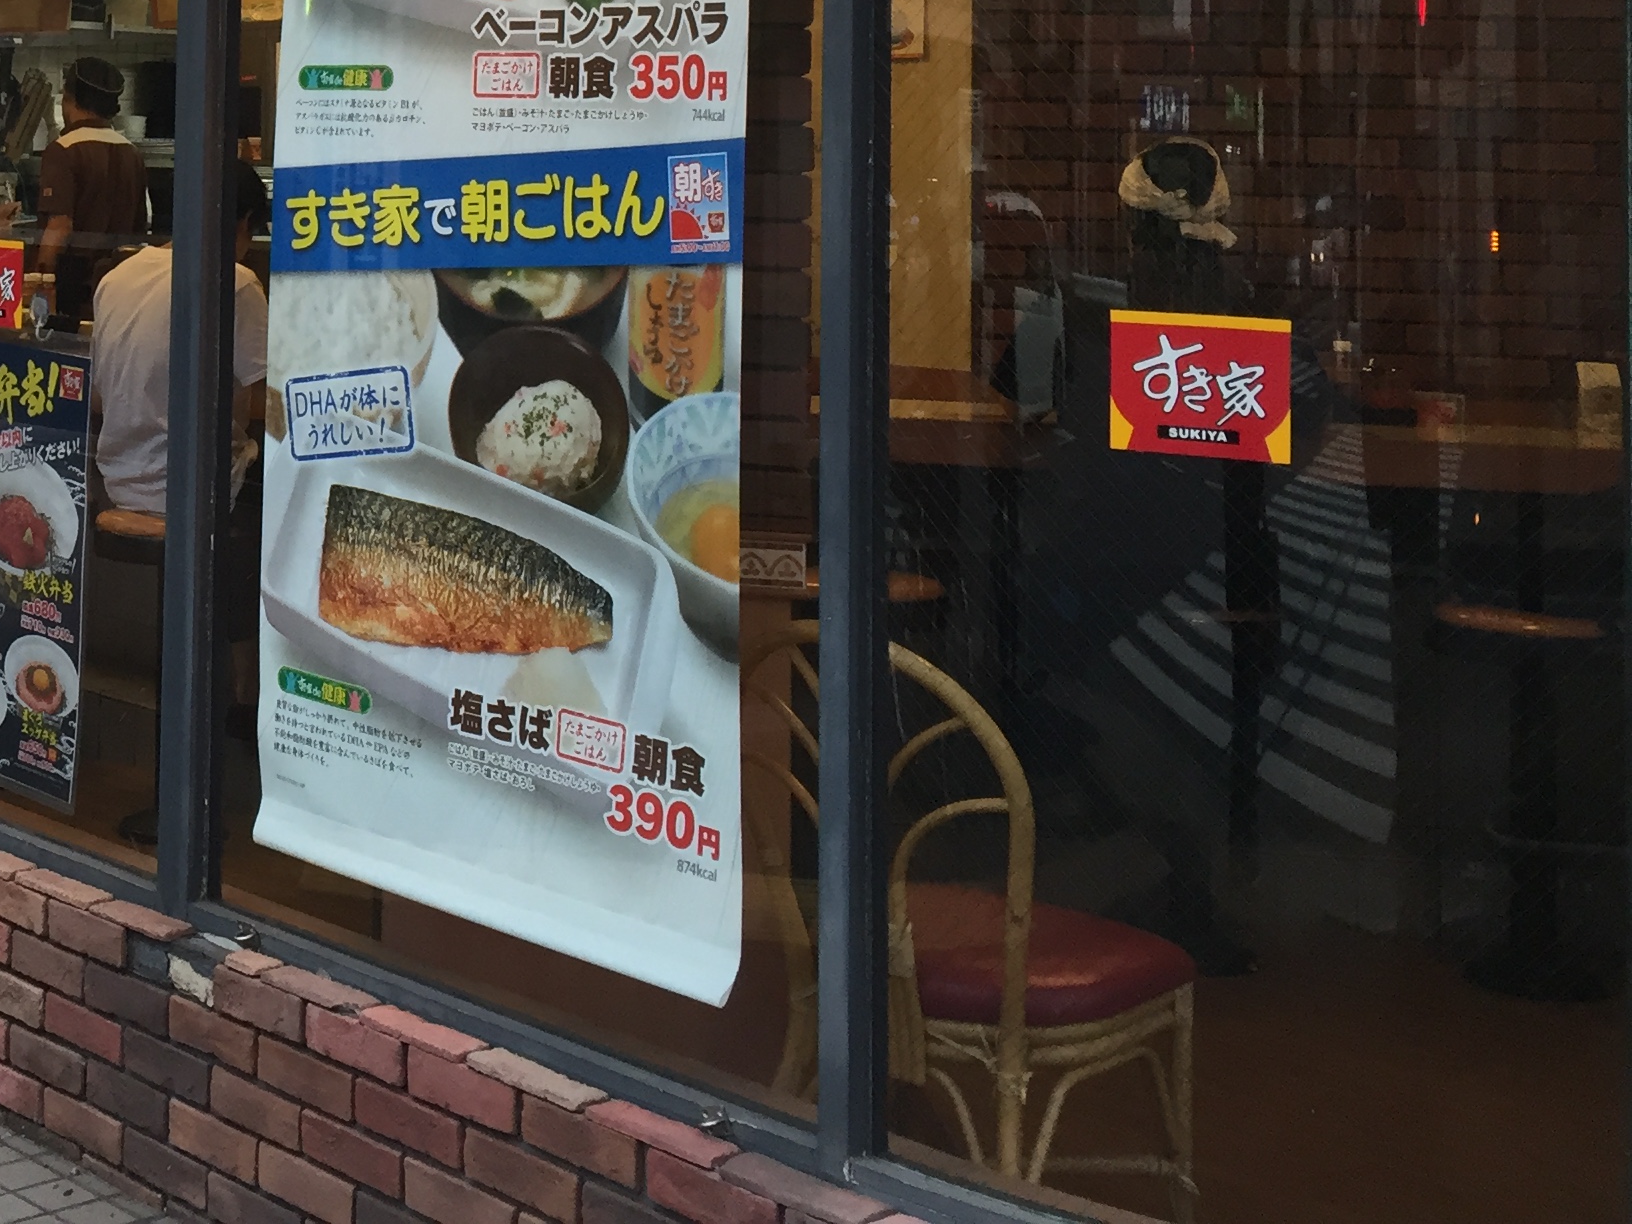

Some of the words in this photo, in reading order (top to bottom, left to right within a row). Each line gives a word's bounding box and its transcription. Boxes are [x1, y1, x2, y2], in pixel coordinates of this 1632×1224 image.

[474, 0, 729, 45] ベーコンアスパラ
[481, 60, 534, 75] たまごかけ
[490, 77, 524, 92] ごはん
[548, 56, 616, 100] 朝食
[629, 54, 728, 102] 350円
[692, 108, 726, 122] 744kcal
[672, 162, 724, 204] 朝すき
[286, 170, 665, 250] すき家で朝ごはん
[1132, 333, 1267, 426] すき家
[294, 383, 401, 418] DHAが体に
[308, 417, 386, 450] うれしい!
[1168, 427, 1228, 443] SUKIYA
[450, 688, 554, 752] 塩さば
[564, 719, 619, 748] たまごかけ
[573, 741, 608, 762] ごはん
[631, 733, 707, 798] 朝食
[606, 784, 721, 862] 390円
[675, 858, 718, 883] 874kcal
